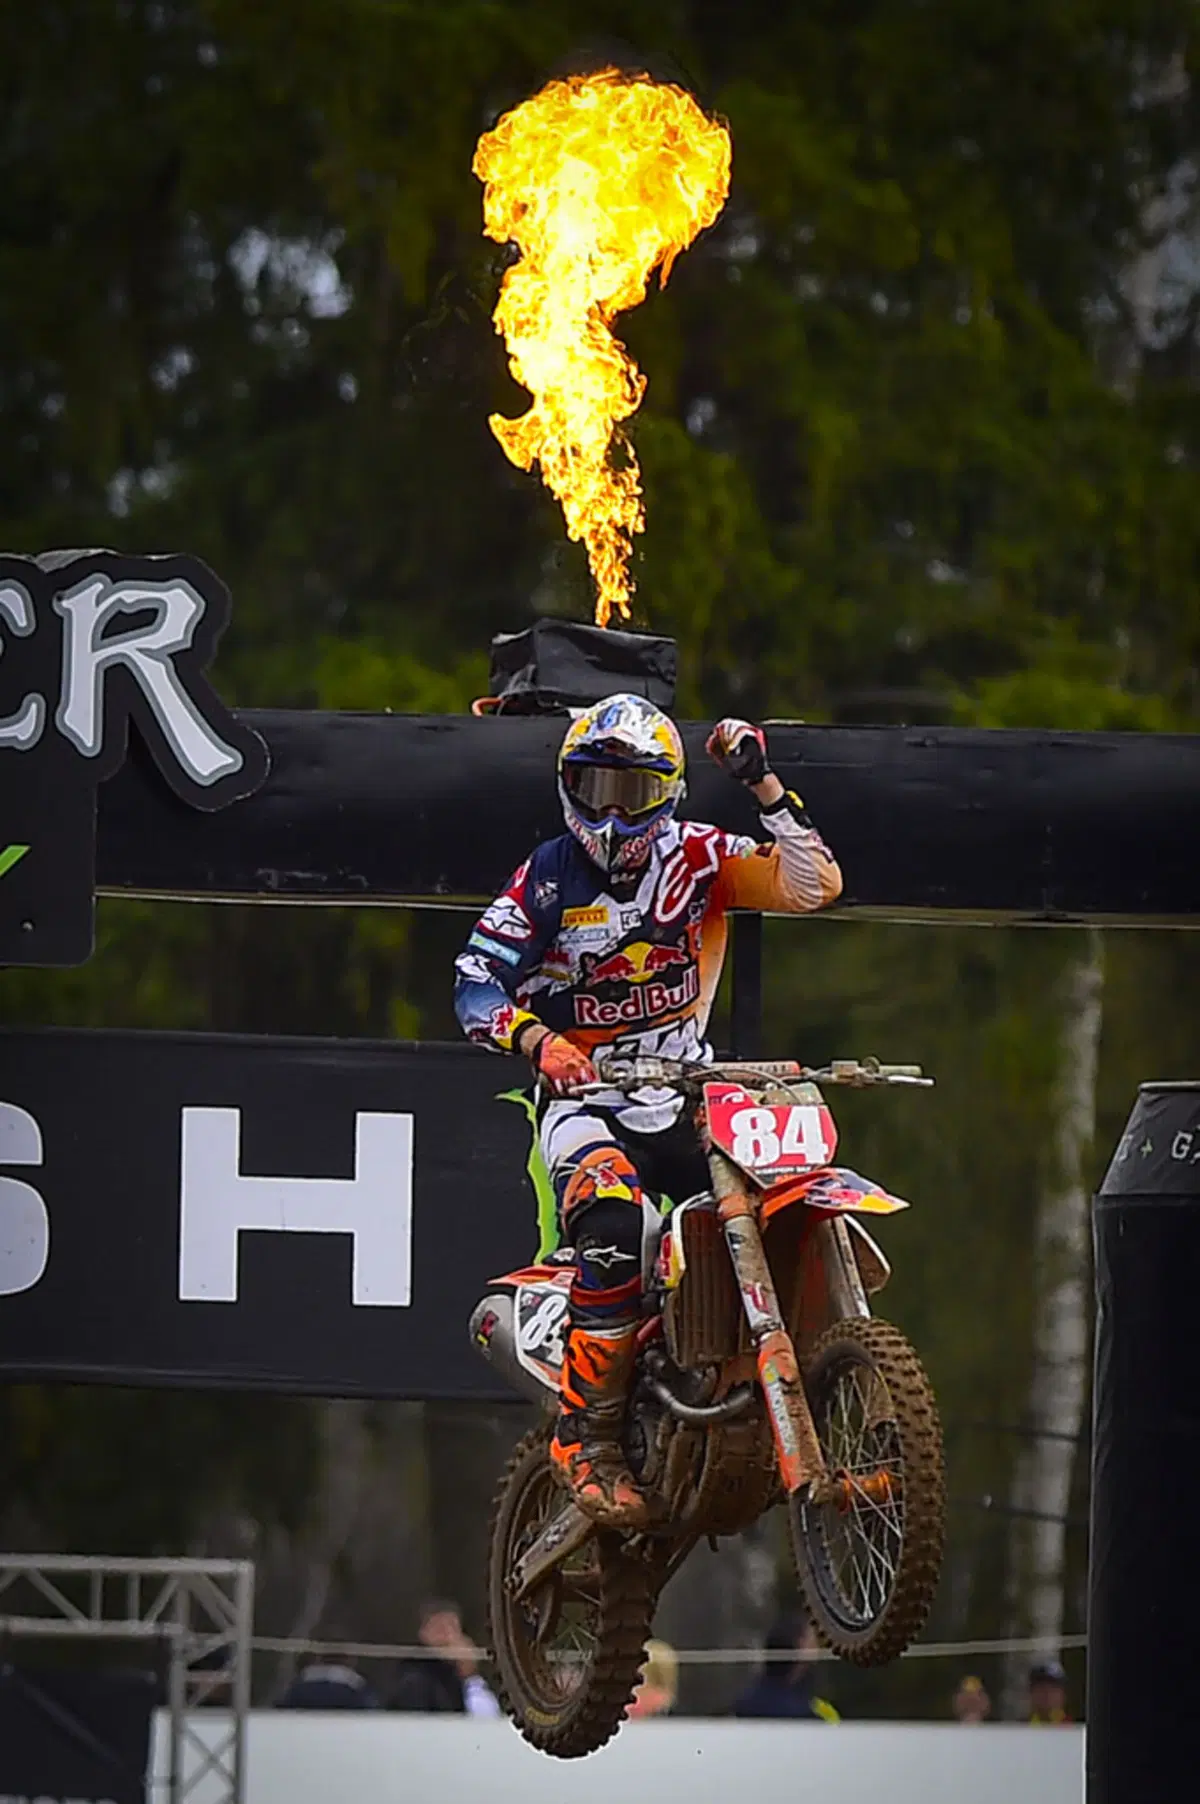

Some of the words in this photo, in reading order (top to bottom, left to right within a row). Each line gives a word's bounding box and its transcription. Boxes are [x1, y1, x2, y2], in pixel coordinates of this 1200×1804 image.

[574, 986, 643, 1024] Red
[645, 964, 697, 1015] Bull
[731, 1105, 829, 1167] 84
[0, 1103, 414, 1307] H
